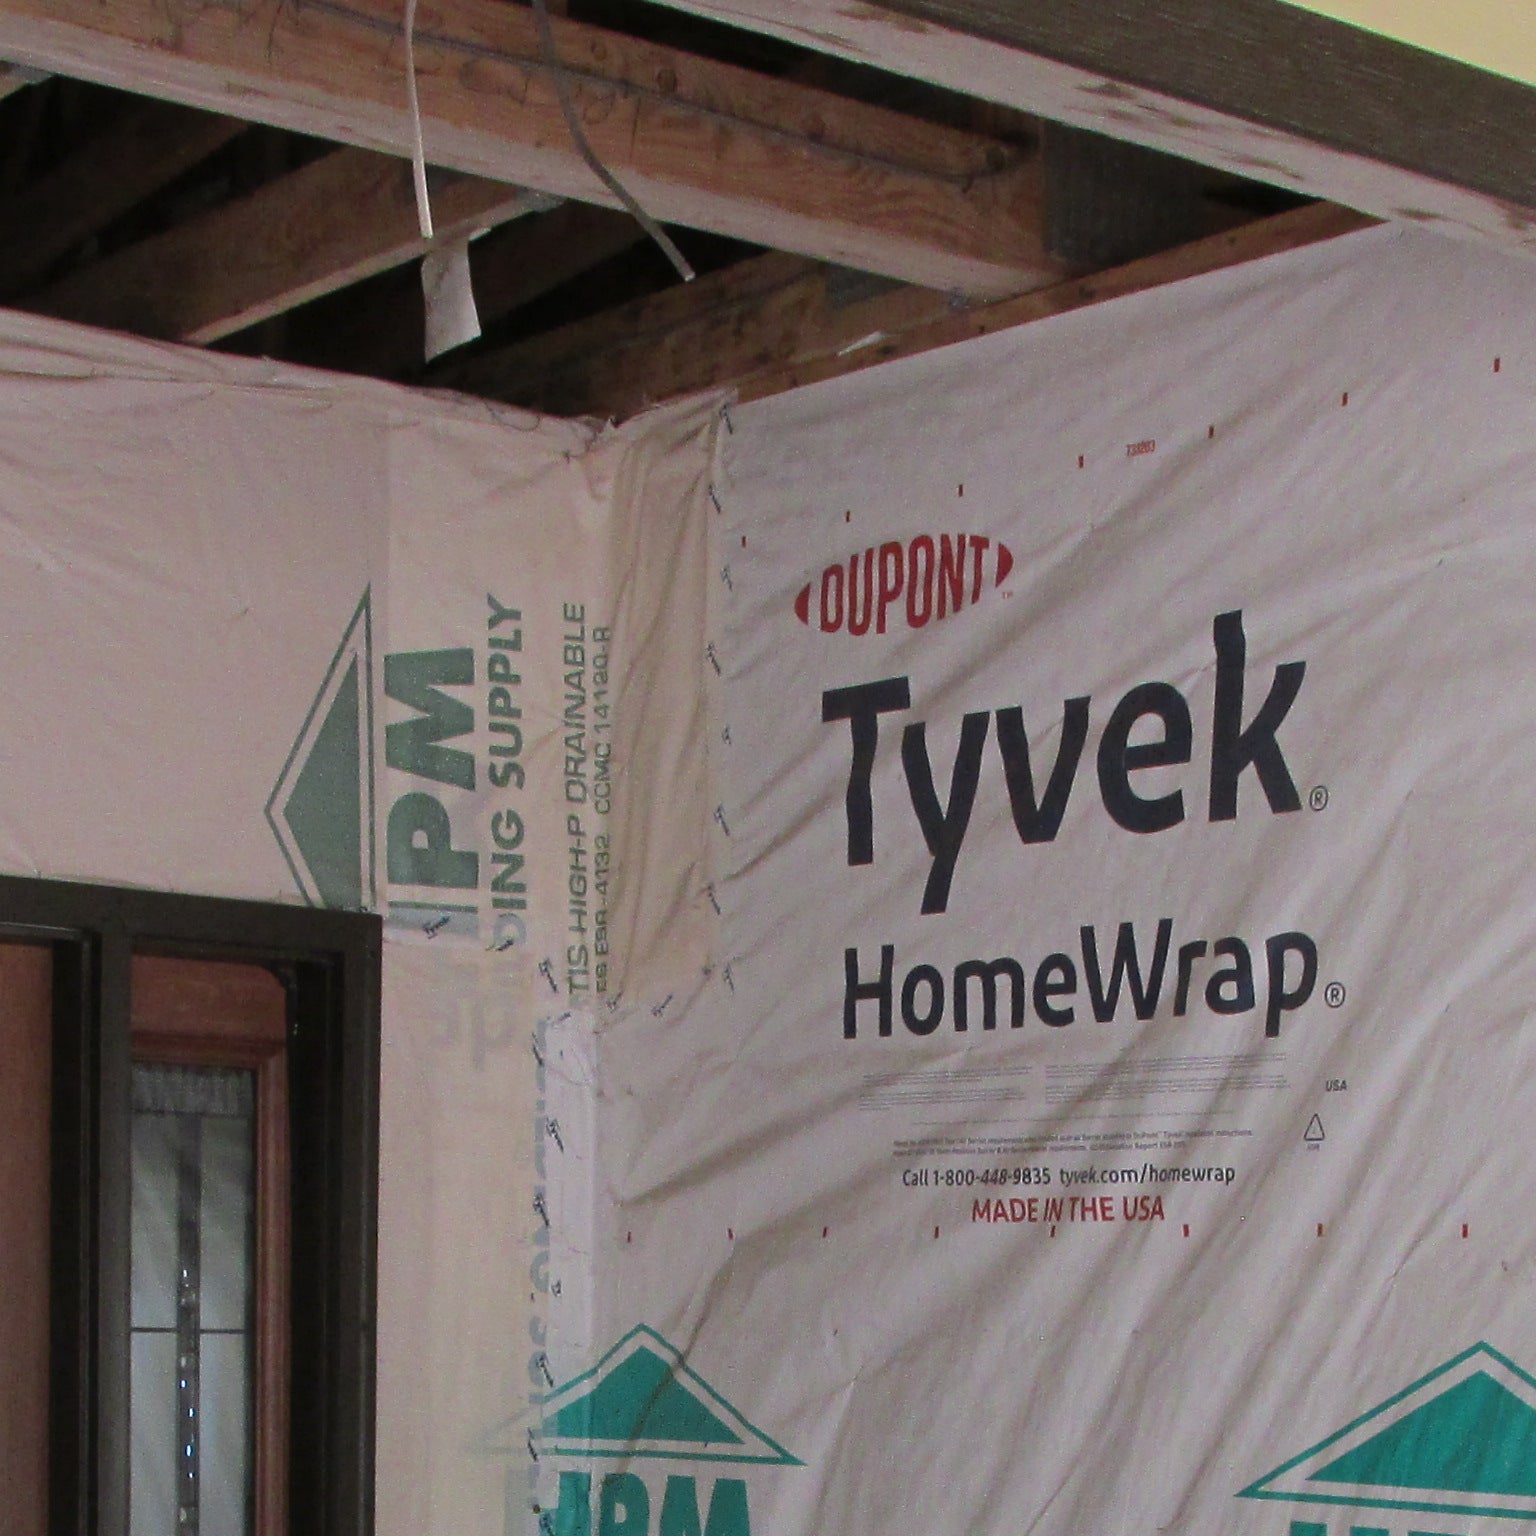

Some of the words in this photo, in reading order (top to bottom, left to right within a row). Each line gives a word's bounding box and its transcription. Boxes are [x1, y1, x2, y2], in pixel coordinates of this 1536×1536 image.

[819, 532, 991, 636] DUPONT
[486, 592, 526, 790] SUPPLY
[563, 601, 588, 805] DRAINABLE
[821, 608, 1307, 915] Tyvek
[842, 917, 1318, 1038] HomeWrap
[1325, 1079, 1348, 1093] USA
[902, 1168, 929, 1188] Call
[932, 1166, 1052, 1187] 1-800-448-9835
[1058, 1163, 1237, 1187] tyvek.com/homewrap
[971, 1197, 1038, 1223] MADE
[1042, 1197, 1064, 1223] IN
[1068, 1196, 1115, 1223] THE
[1122, 1195, 1166, 1222] USA
